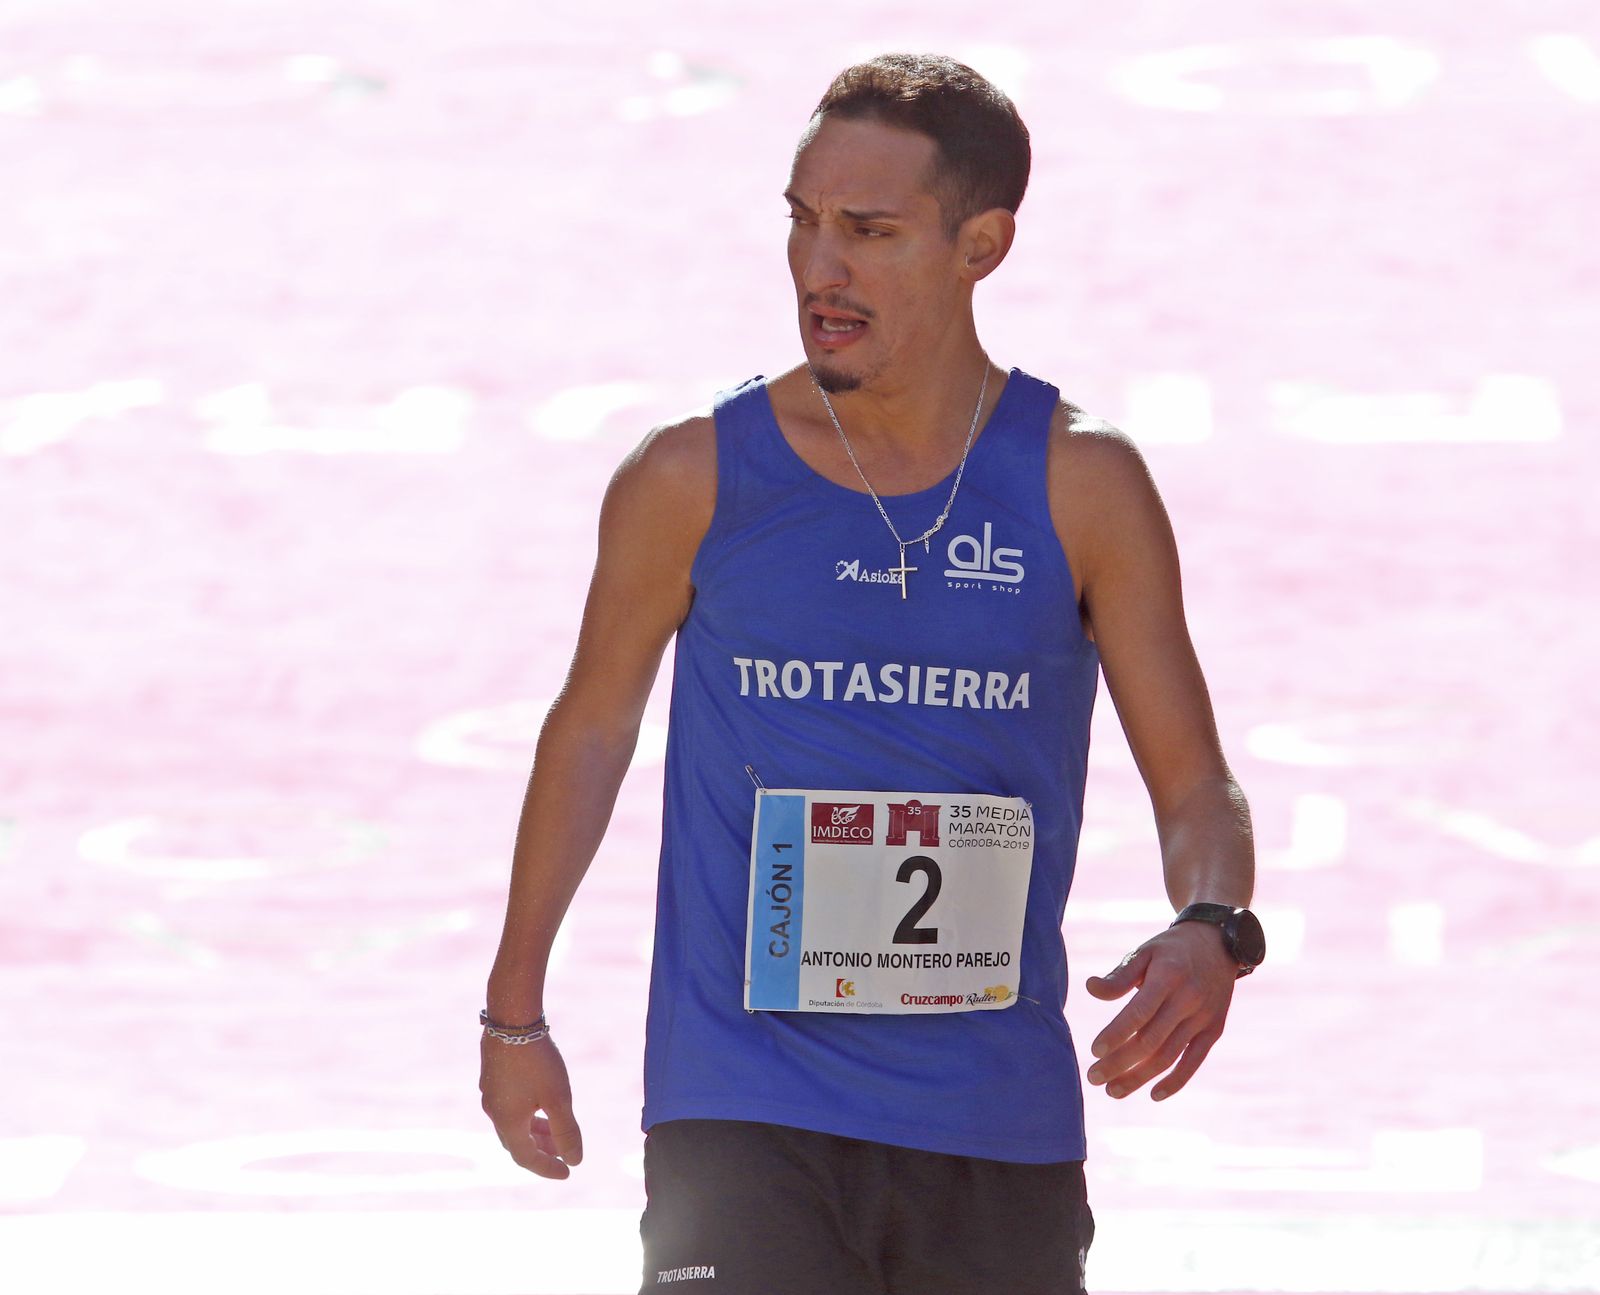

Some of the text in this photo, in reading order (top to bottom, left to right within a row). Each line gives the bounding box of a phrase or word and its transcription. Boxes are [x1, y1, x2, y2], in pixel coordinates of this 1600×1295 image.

[944, 522, 1025, 584] als
[947, 582, 1021, 594] sport shop
[733, 657, 1031, 710] TROTASIERRA
[907, 807, 921, 815] 35
[950, 805, 1031, 821] 35 MEDIA
[812, 826, 872, 839] IMDECO
[949, 822, 1031, 838] MARATÓN
[948, 837, 1030, 849] CÓRDOBA 2019
[765, 842, 793, 958] CAJÓN 1
[892, 855, 942, 944] 2
[801, 951, 1011, 968] ANTONIO MONTERO PAREJO
[808, 999, 845, 1008] Diputación
[900, 993, 963, 1006] Cruzcampo
[657, 1265, 715, 1283] TROTASIERRA
